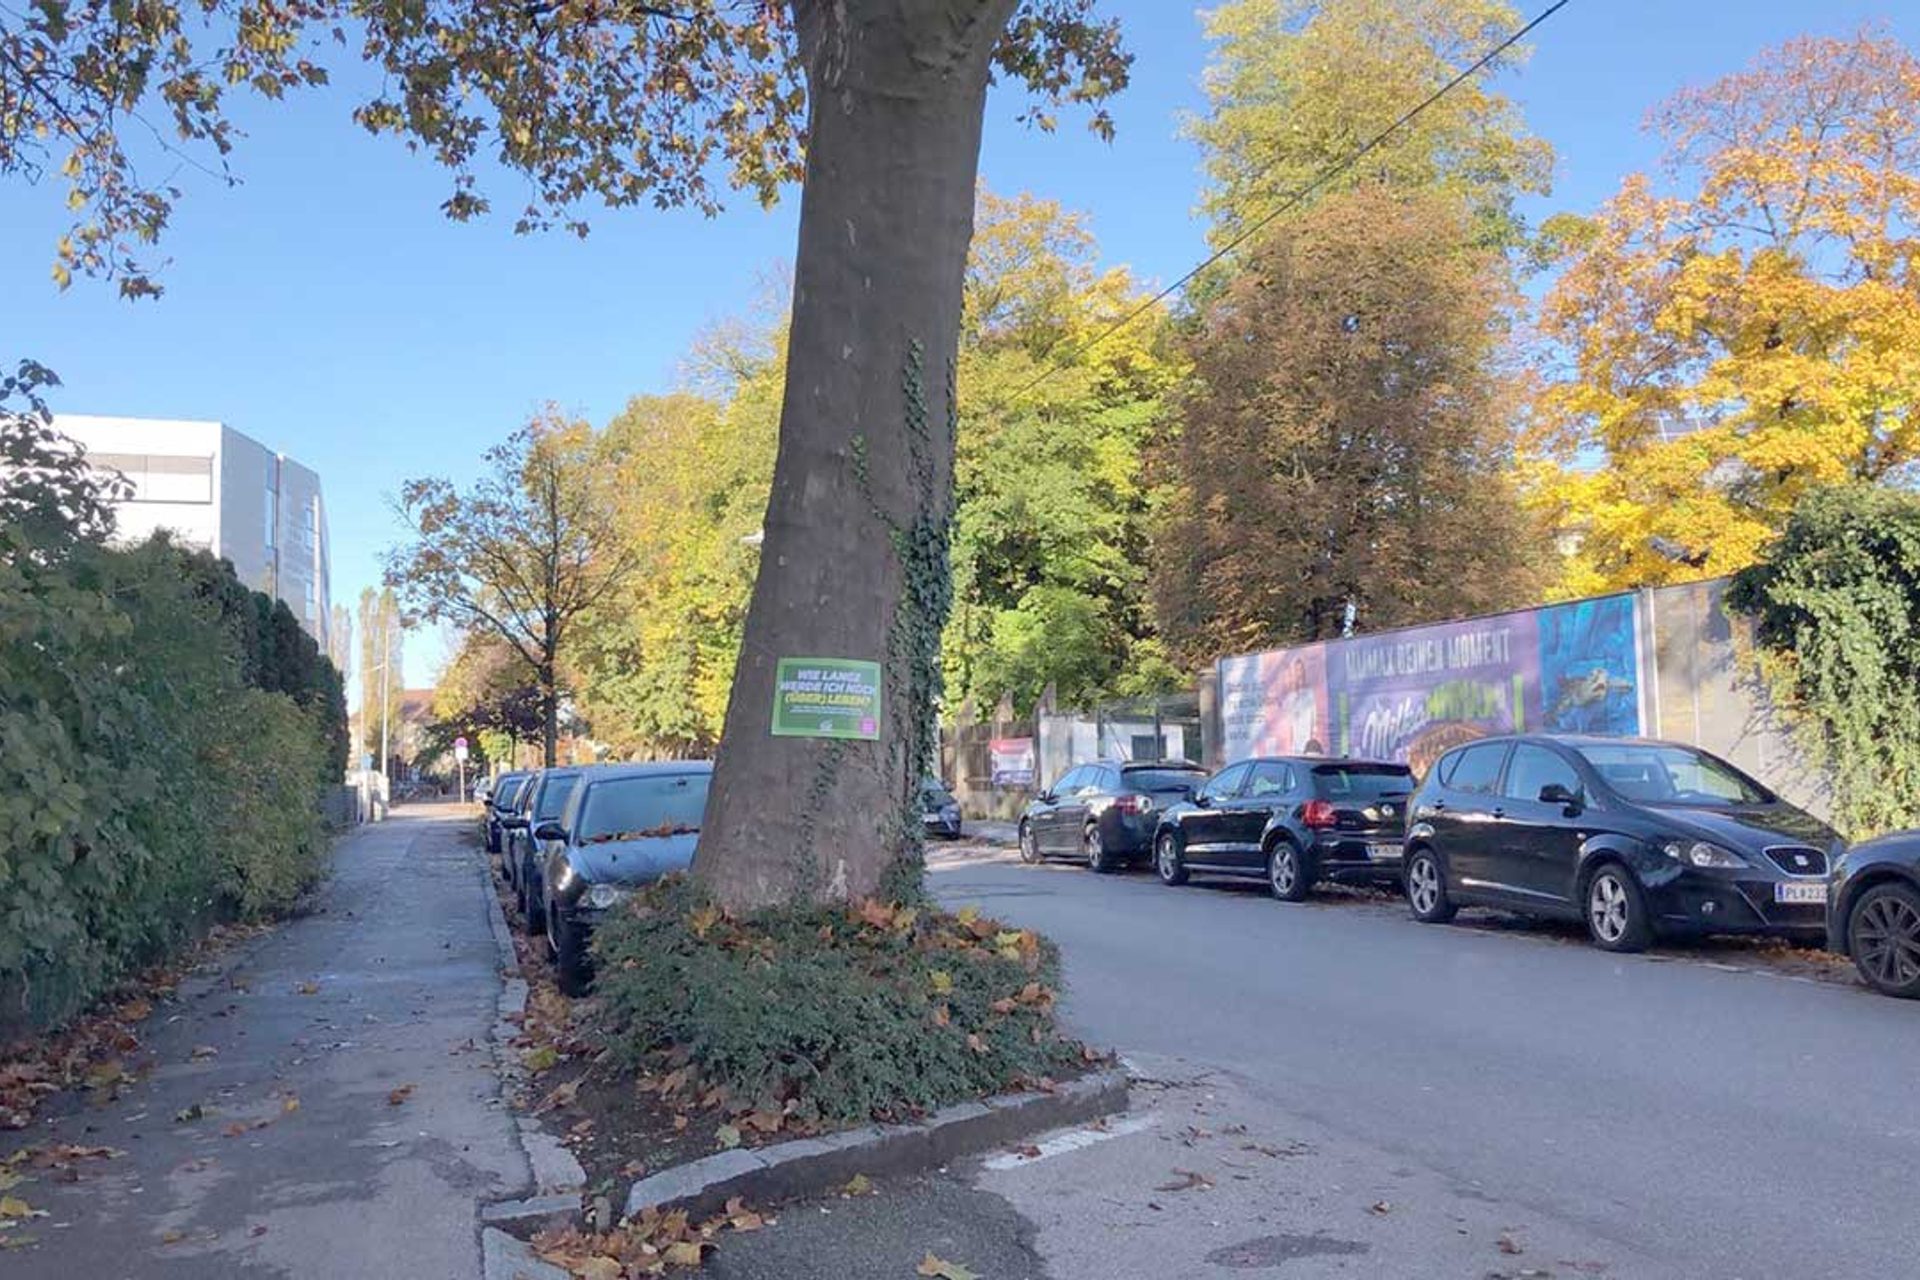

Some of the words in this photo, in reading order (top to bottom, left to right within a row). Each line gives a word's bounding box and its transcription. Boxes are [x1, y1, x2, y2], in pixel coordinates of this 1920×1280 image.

[1449, 628, 1510, 669] MOMENT
[798, 669, 820, 680] WIE
[821, 670, 861, 682] LANGE
[823, 682, 846, 693] ICH
[1361, 696, 1430, 760] Milka
